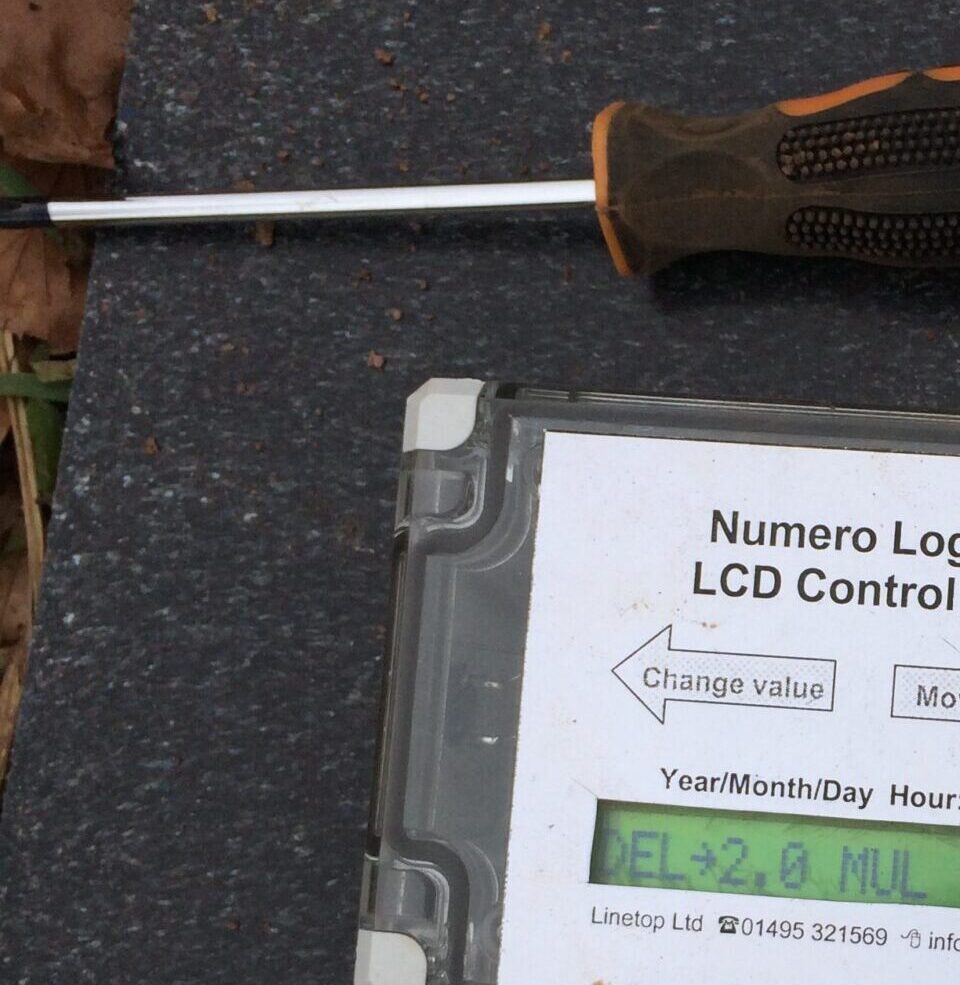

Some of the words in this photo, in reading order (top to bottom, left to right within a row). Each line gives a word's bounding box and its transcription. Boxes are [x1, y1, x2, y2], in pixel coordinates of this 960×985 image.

[709, 508, 878, 554] Numero
[692, 560, 783, 600] LCD
[796, 566, 956, 612] Control
[642, 666, 745, 699] Change
[752, 675, 825, 701] value
[659, 767, 875, 811] Year/Month/Day
[839, 843, 928, 900] MUL
[590, 905, 666, 934] Linetop
[671, 912, 704, 933] Ltd
[740, 917, 805, 941] 01495
[810, 922, 888, 947] 321569
